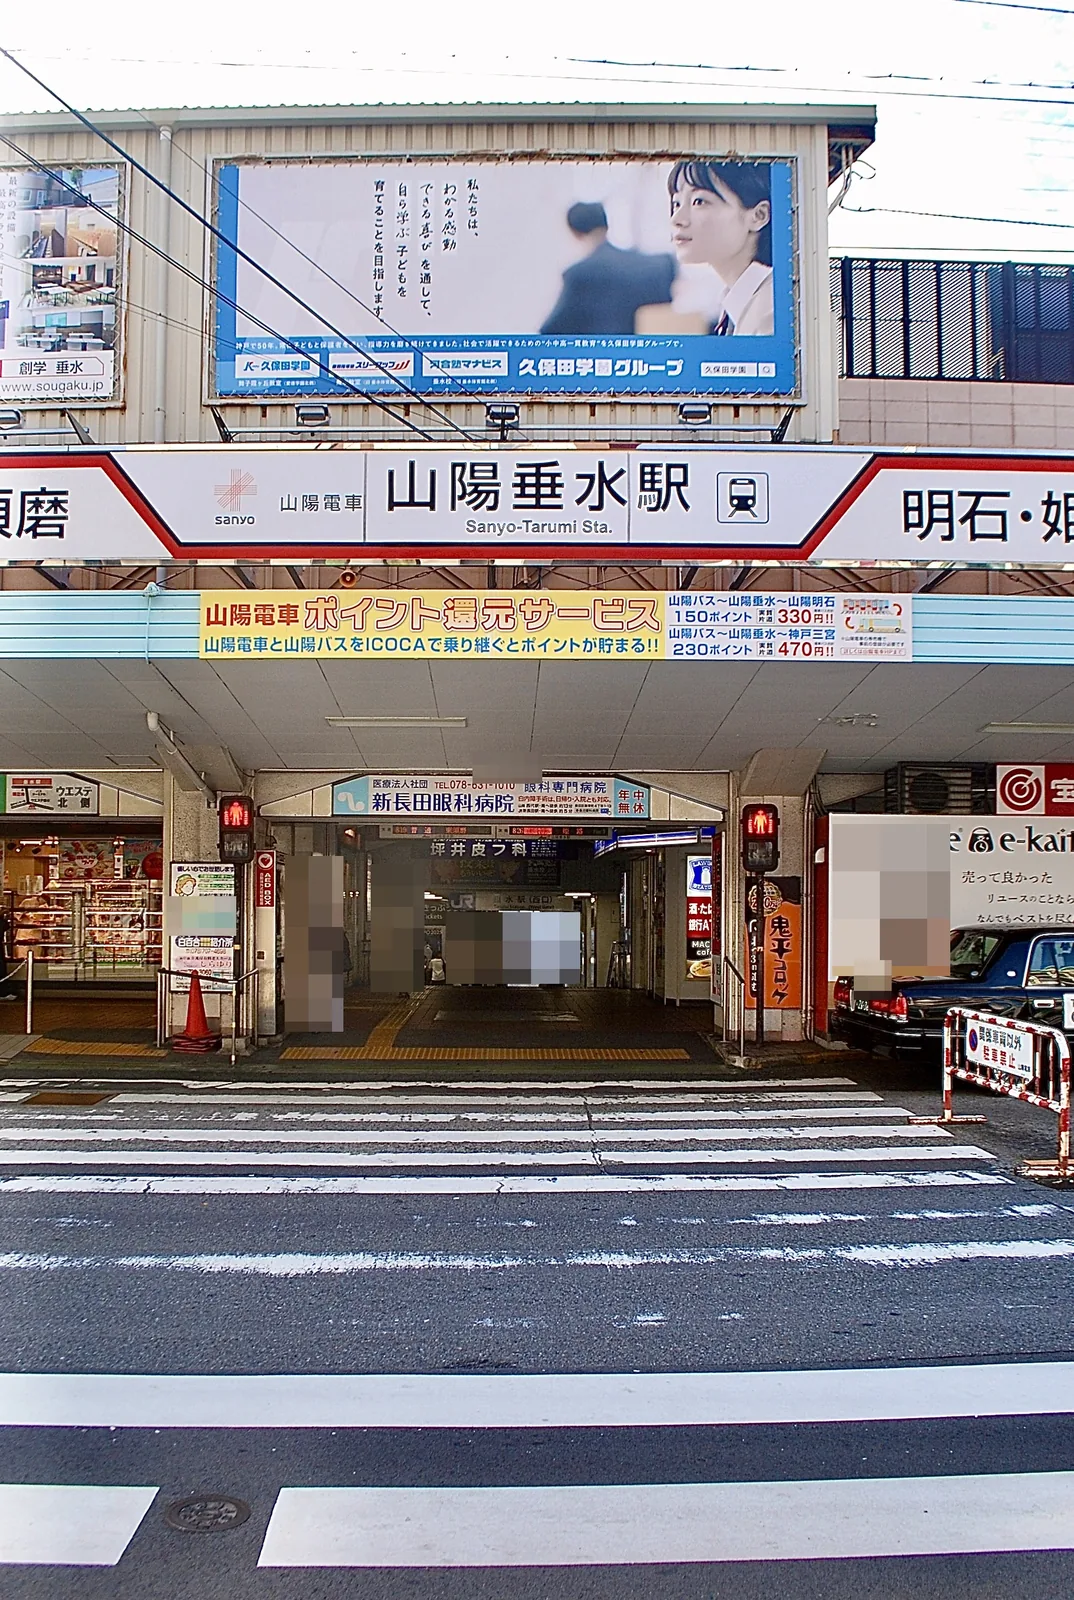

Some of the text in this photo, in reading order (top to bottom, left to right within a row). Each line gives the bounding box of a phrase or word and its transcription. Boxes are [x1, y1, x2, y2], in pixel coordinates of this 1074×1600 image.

[467, 178, 480, 237] 私たちは、
[441, 183, 457, 251] わかる感動
[19, 360, 84, 376] 創学 垂水
[261, 360, 310, 371] 久保田学園
[429, 359, 502, 369] 河合塾マナビス
[518, 358, 684, 376] 久保田学園グループ
[1, 379, 104, 393] www.sougaku.jp
[387, 460, 690, 513] 山陽垂水駅
[280, 494, 362, 512] 山陽電車
[0, 487, 69, 541] 磨
[215, 514, 255, 526] sanyo
[466, 519, 614, 536] Sanyo-Tarumi Sta.
[206, 596, 662, 632] 山陽電車 ポイント還元サービス
[674, 610, 753, 624] 150ポイント
[673, 643, 753, 656] 230ポイント
[56, 785, 92, 797] ウエステ
[372, 779, 428, 789] 医療法人社団
[524, 781, 607, 794] 眼科専門病院
[58, 797, 90, 808] 北側
[618, 789, 644, 801] 年中
[372, 792, 515, 814] 新長田眼科病院
[618, 802, 645, 814] 無休
[430, 842, 527, 857] 坪井皮フ科
[962, 870, 1053, 884] 売って良かった
[264, 872, 272, 906] AED BOX
[451, 893, 474, 908] JR
[988, 893, 1074, 905] リユースのことなら
[769, 914, 793, 1005] 鬼平コロッケ
